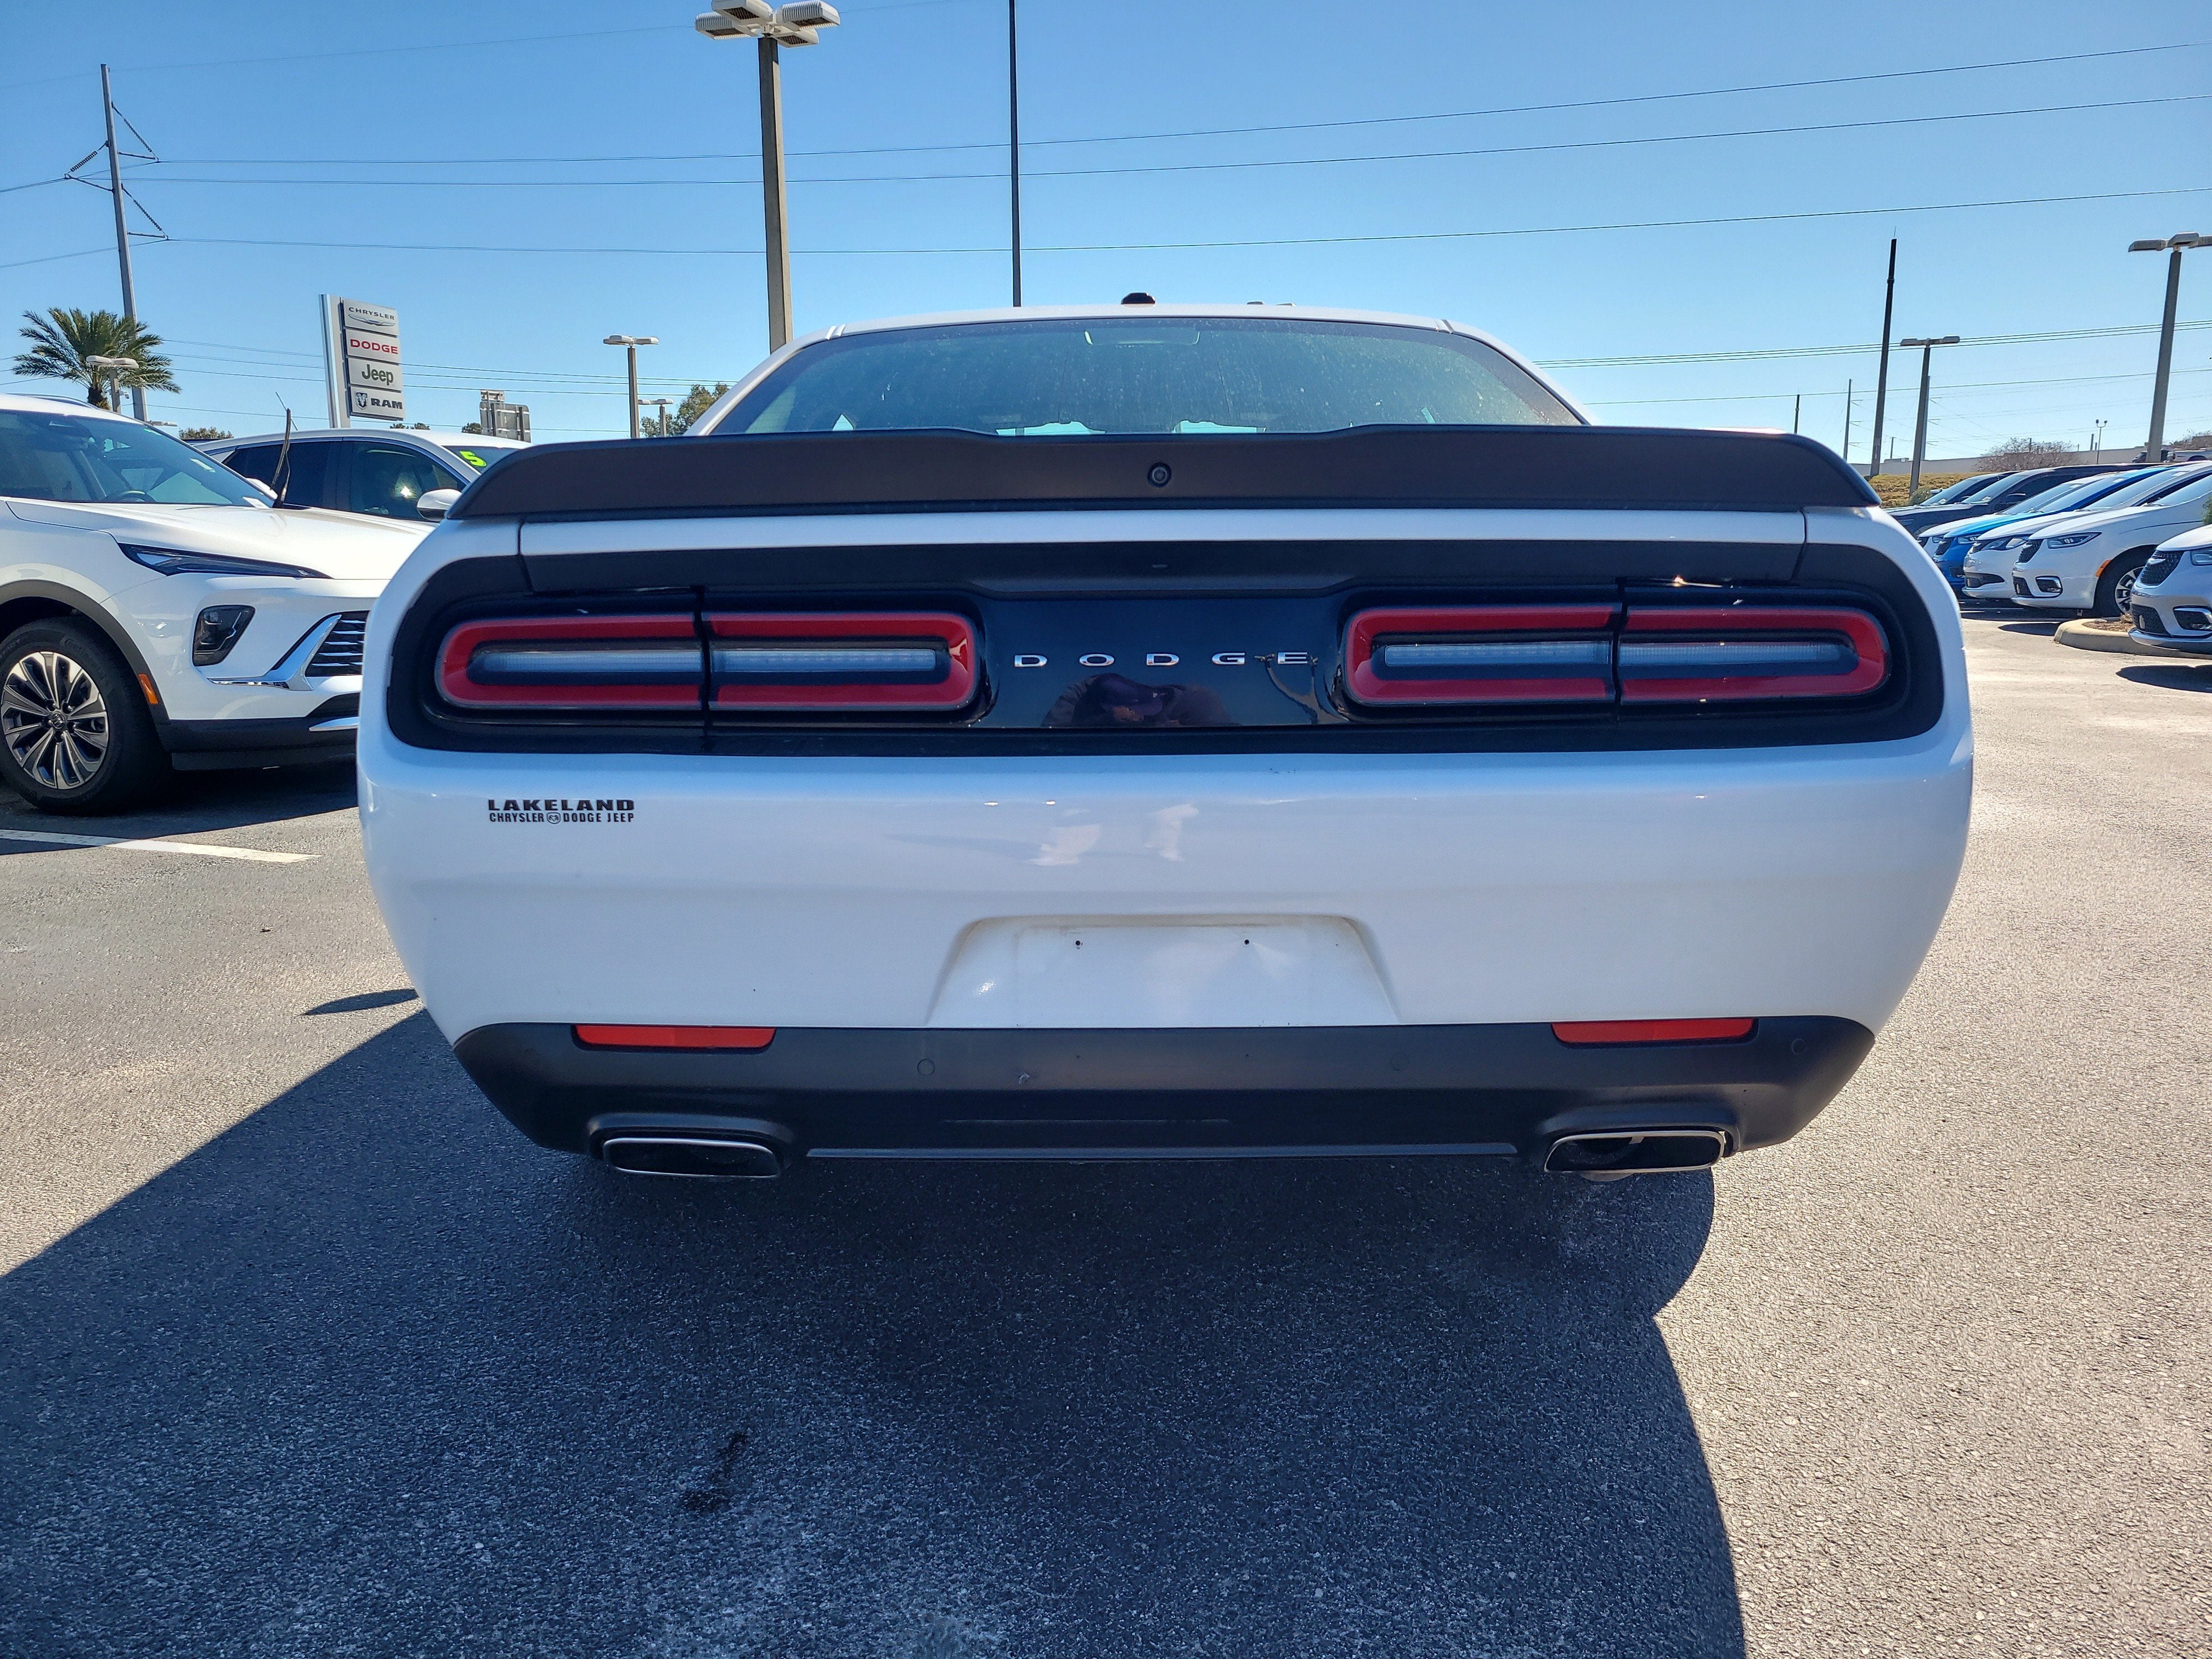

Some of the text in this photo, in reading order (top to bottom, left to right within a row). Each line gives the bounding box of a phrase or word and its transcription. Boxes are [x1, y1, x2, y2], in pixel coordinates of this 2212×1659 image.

[348, 307, 394, 320] CHRYSLER
[350, 338, 398, 354] DODGE
[361, 364, 394, 385] Jeep
[370, 397, 403, 409] RAM
[1014, 652, 1308, 668] DODGE
[488, 799, 635, 811] LAKELAND
[489, 812, 635, 822] CHRYSLER DODGE JEEP
